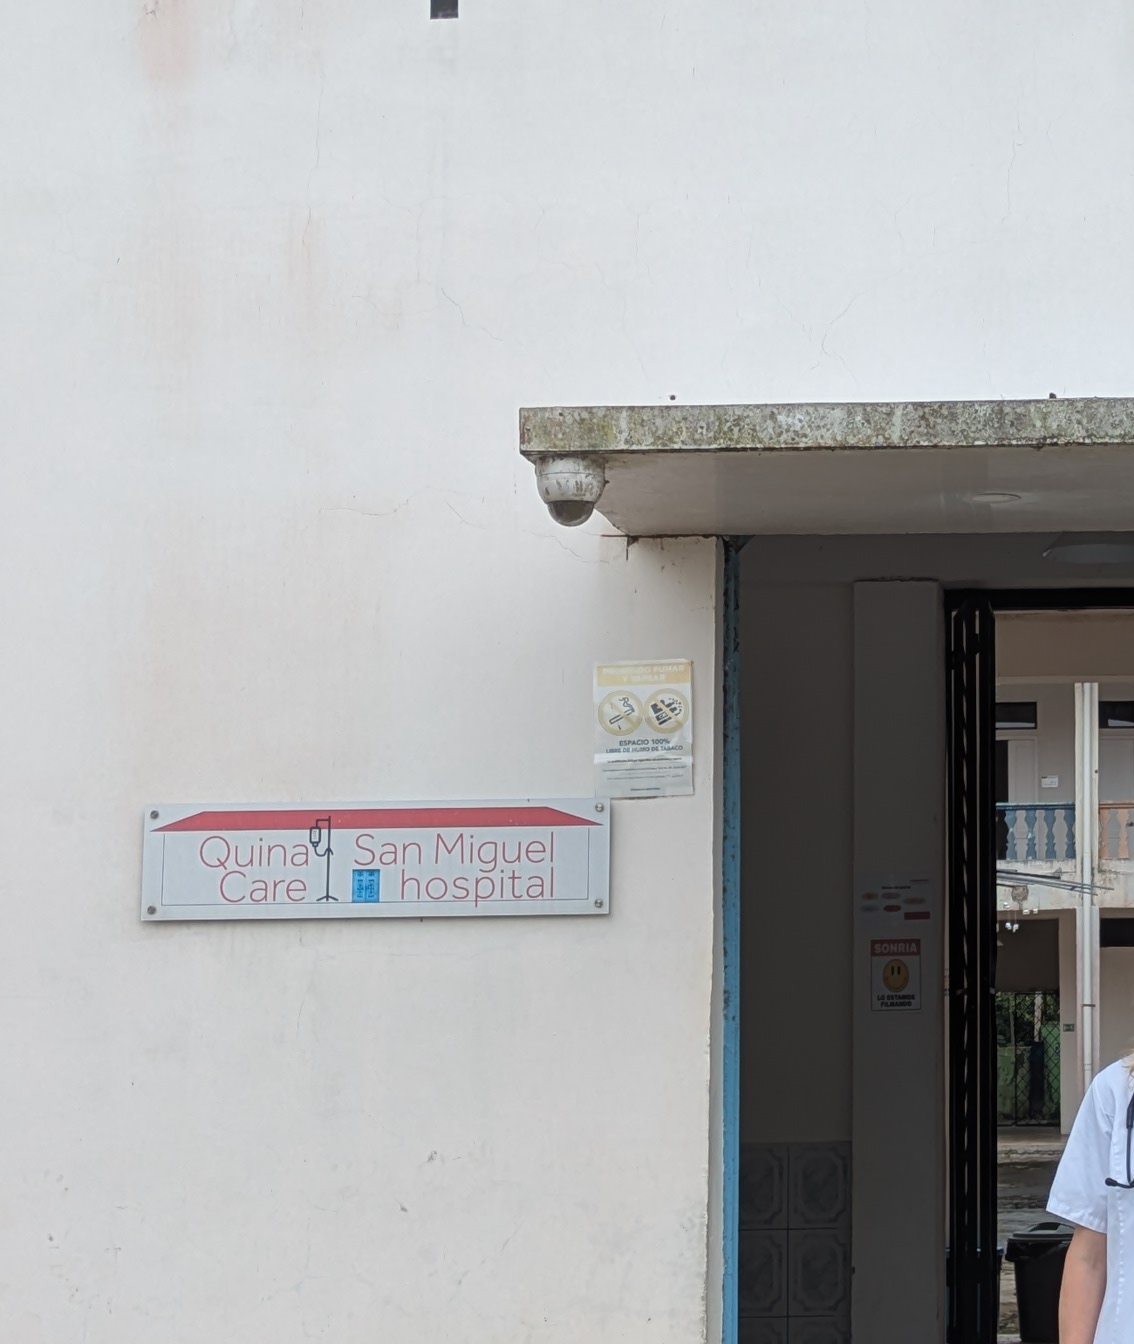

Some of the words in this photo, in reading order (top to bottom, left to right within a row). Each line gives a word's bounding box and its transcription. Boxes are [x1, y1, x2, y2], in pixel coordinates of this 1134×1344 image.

[199, 835, 309, 870] Quina
[354, 833, 422, 866] San
[434, 831, 554, 873] Miguel
[219, 870, 307, 903] Care
[401, 866, 554, 908] hospital
